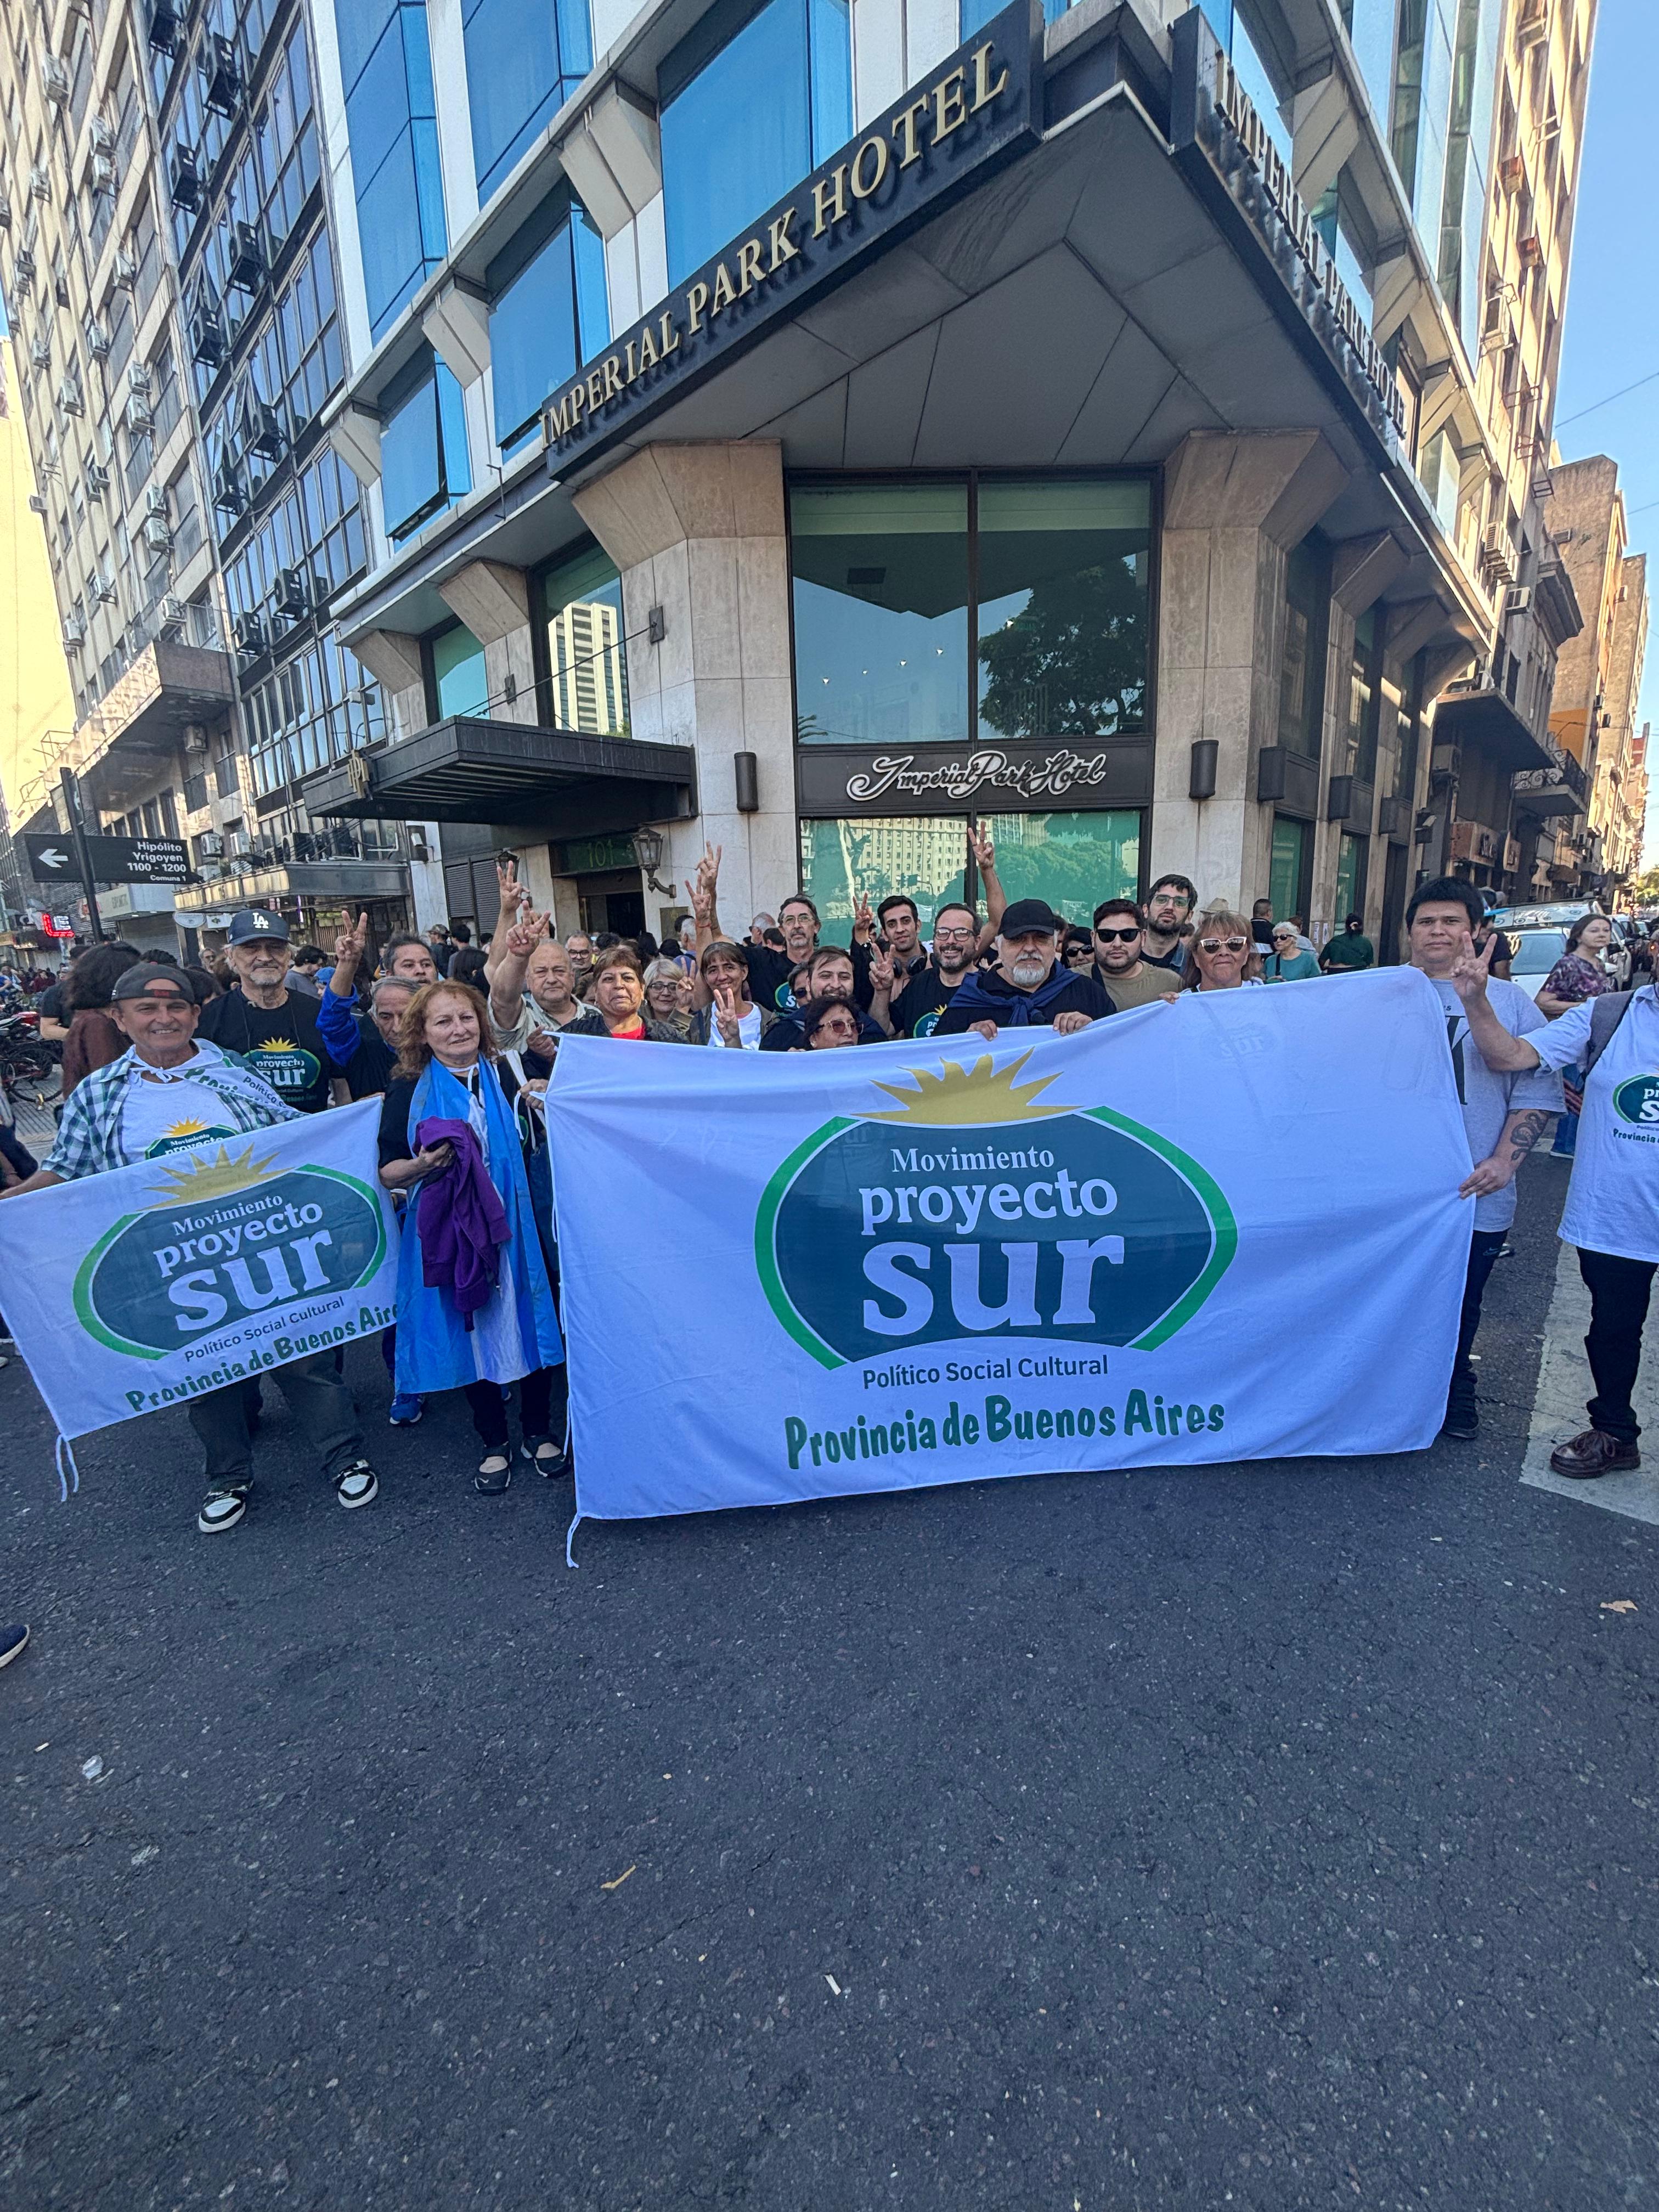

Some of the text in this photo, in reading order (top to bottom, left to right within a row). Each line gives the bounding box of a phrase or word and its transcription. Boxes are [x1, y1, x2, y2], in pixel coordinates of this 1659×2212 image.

[540, 41, 1011, 449] IMPERIAL PARK HOTEL
[846, 749, 1107, 802] Imperial Park Hotel
[132, 852, 183, 863] Yrigoyen
[137, 841, 182, 853] Hipólito
[588, 839, 613, 868] 101
[127, 862, 151, 871] 1100
[162, 864, 187, 872] 1200
[252, 912, 269, 929] LA
[242, 1076, 276, 1104] Político
[170, 1133, 210, 1147] Movimiento
[1613, 1128, 1656, 1143] Provincia
[890, 1146, 1054, 1172] Movimiento
[172, 1195, 283, 1235] Movimiento
[859, 1169, 1118, 1235] proyecto
[153, 1203, 323, 1278] proyecto
[168, 1230, 332, 1331] sur
[863, 1235, 1125, 1336] sur
[185, 1296, 345, 1362] Político Social Cultural
[125, 1304, 397, 1412] Provincia de Buenos Air
[862, 1355, 1108, 1390] Político Social Cultural
[785, 1389, 1225, 1470] Provincia de Buenos Aires
